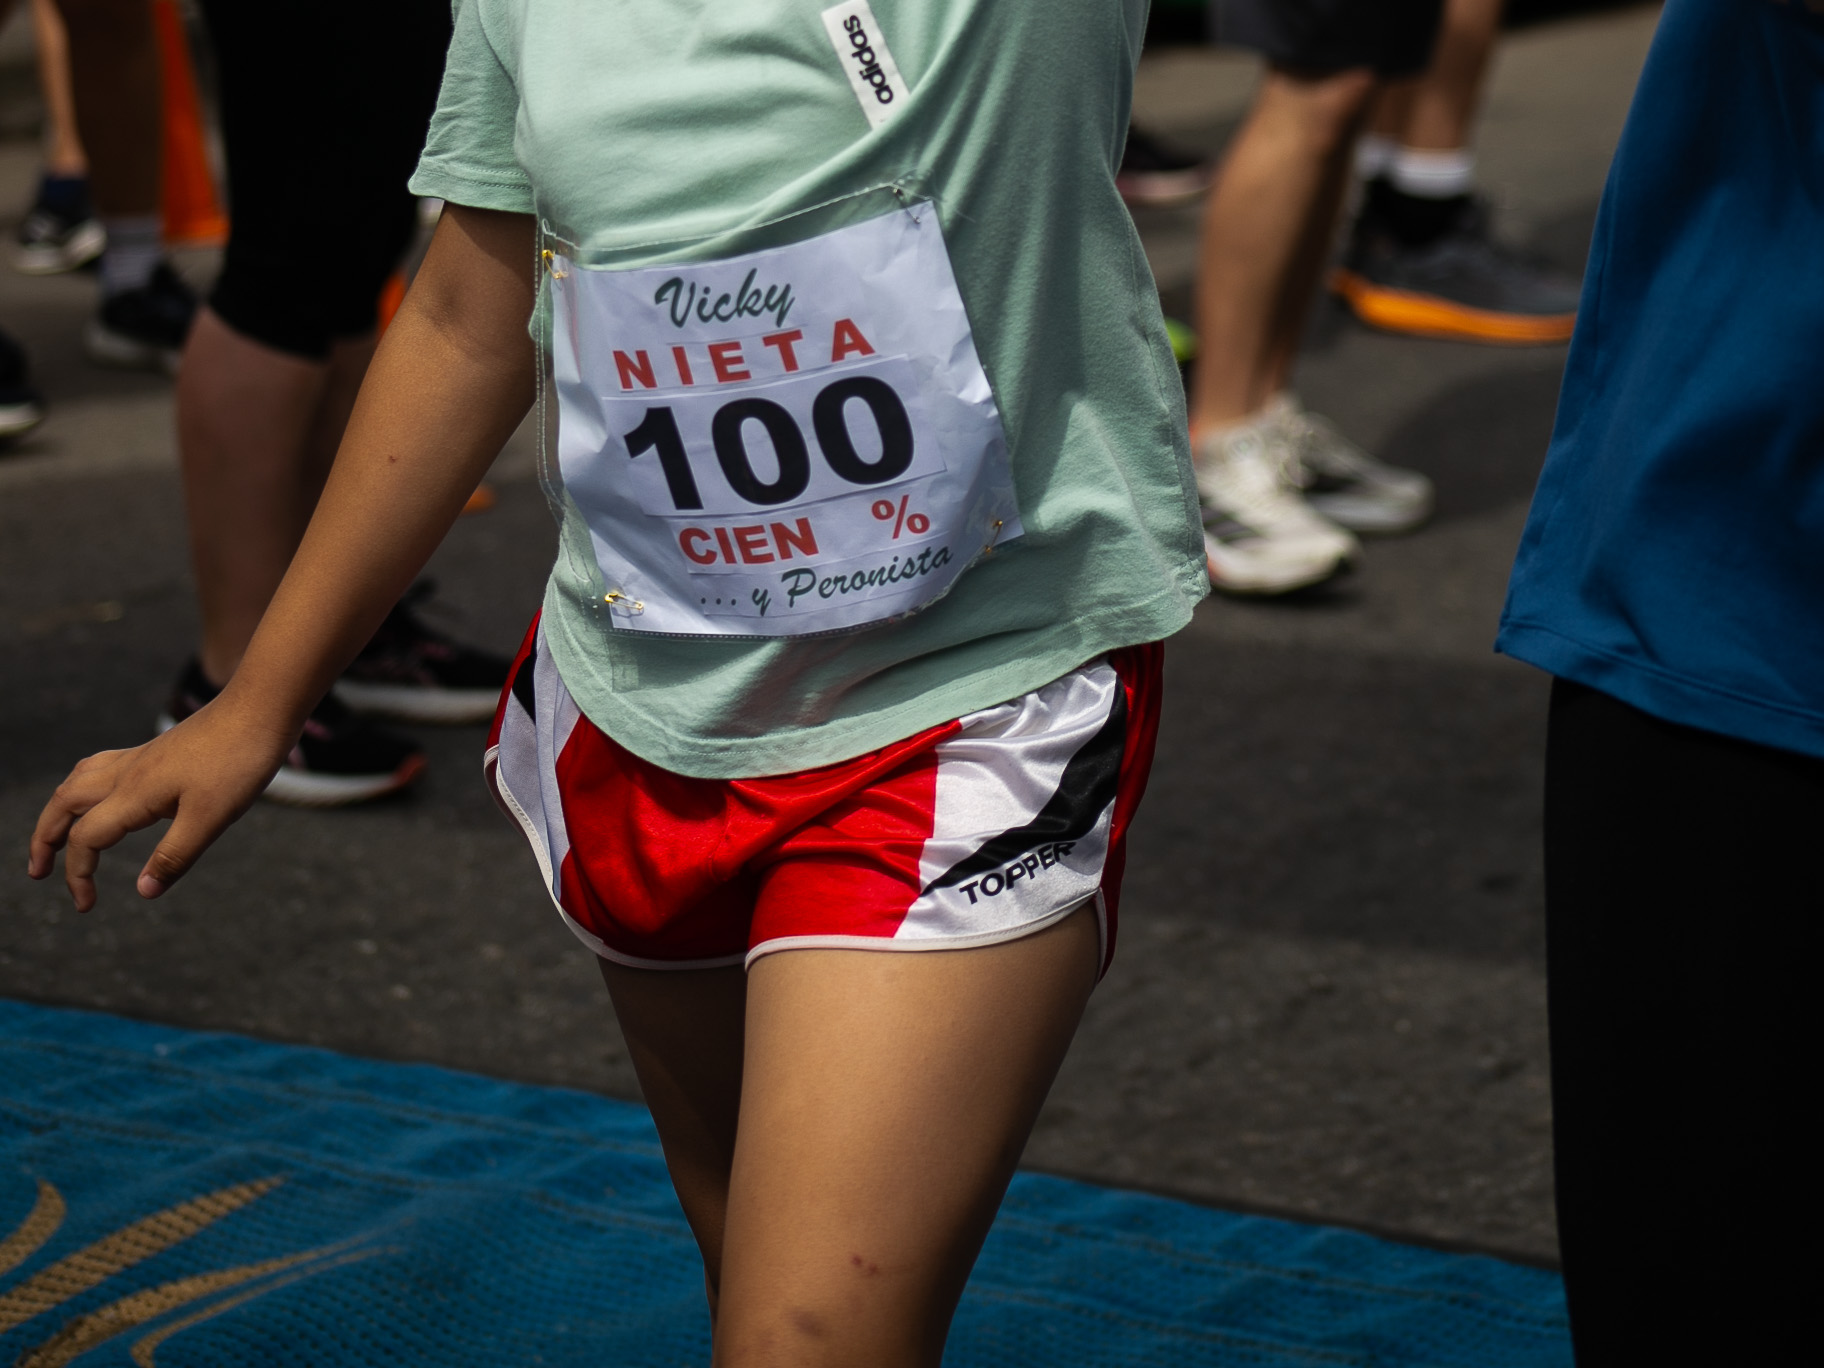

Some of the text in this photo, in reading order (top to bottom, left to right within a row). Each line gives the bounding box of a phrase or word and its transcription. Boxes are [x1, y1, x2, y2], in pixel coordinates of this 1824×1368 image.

[843, 15, 894, 105] adidas
[654, 268, 795, 327] Vicky
[612, 318, 875, 390] NIETA
[623, 376, 914, 510] 100
[678, 495, 930, 565] CIEN %
[781, 543, 953, 608] Peronista
[959, 842, 1076, 905] TOPPER
